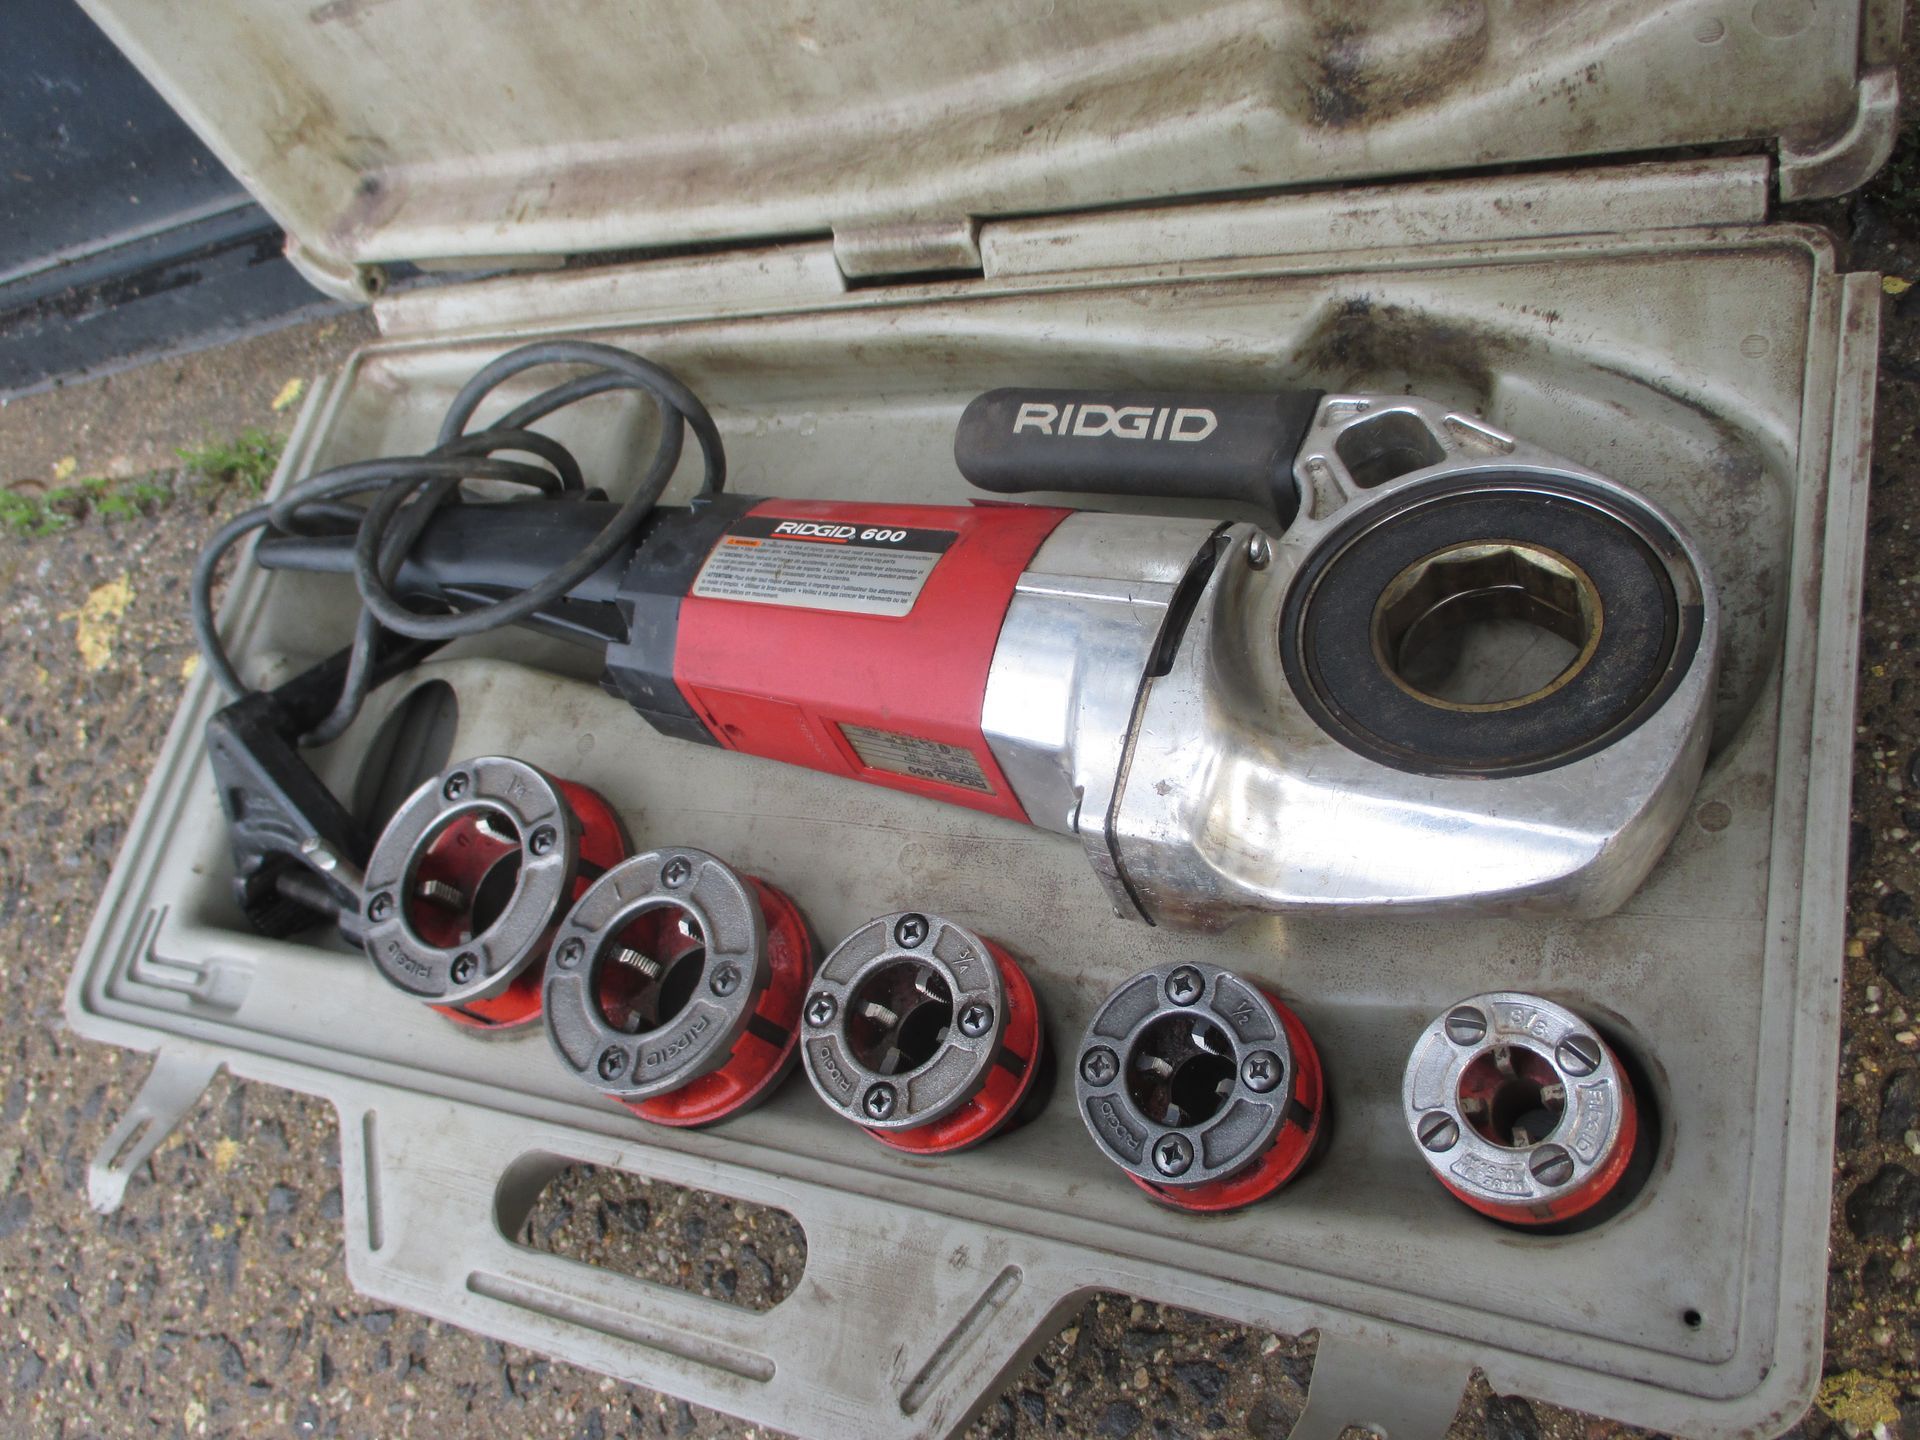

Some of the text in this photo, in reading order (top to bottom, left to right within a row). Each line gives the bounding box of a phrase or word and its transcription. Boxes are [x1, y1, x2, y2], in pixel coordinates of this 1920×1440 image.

[1012, 402, 1218, 442] RIDGID
[861, 528, 907, 543] 600
[908, 766, 934, 777] 600
[1231, 1000, 1254, 1026] 1/2
[646, 1014, 711, 1067] RIDGID
[820, 1045, 852, 1092] RIDGID
[1102, 1101, 1139, 1151] RIDGID
